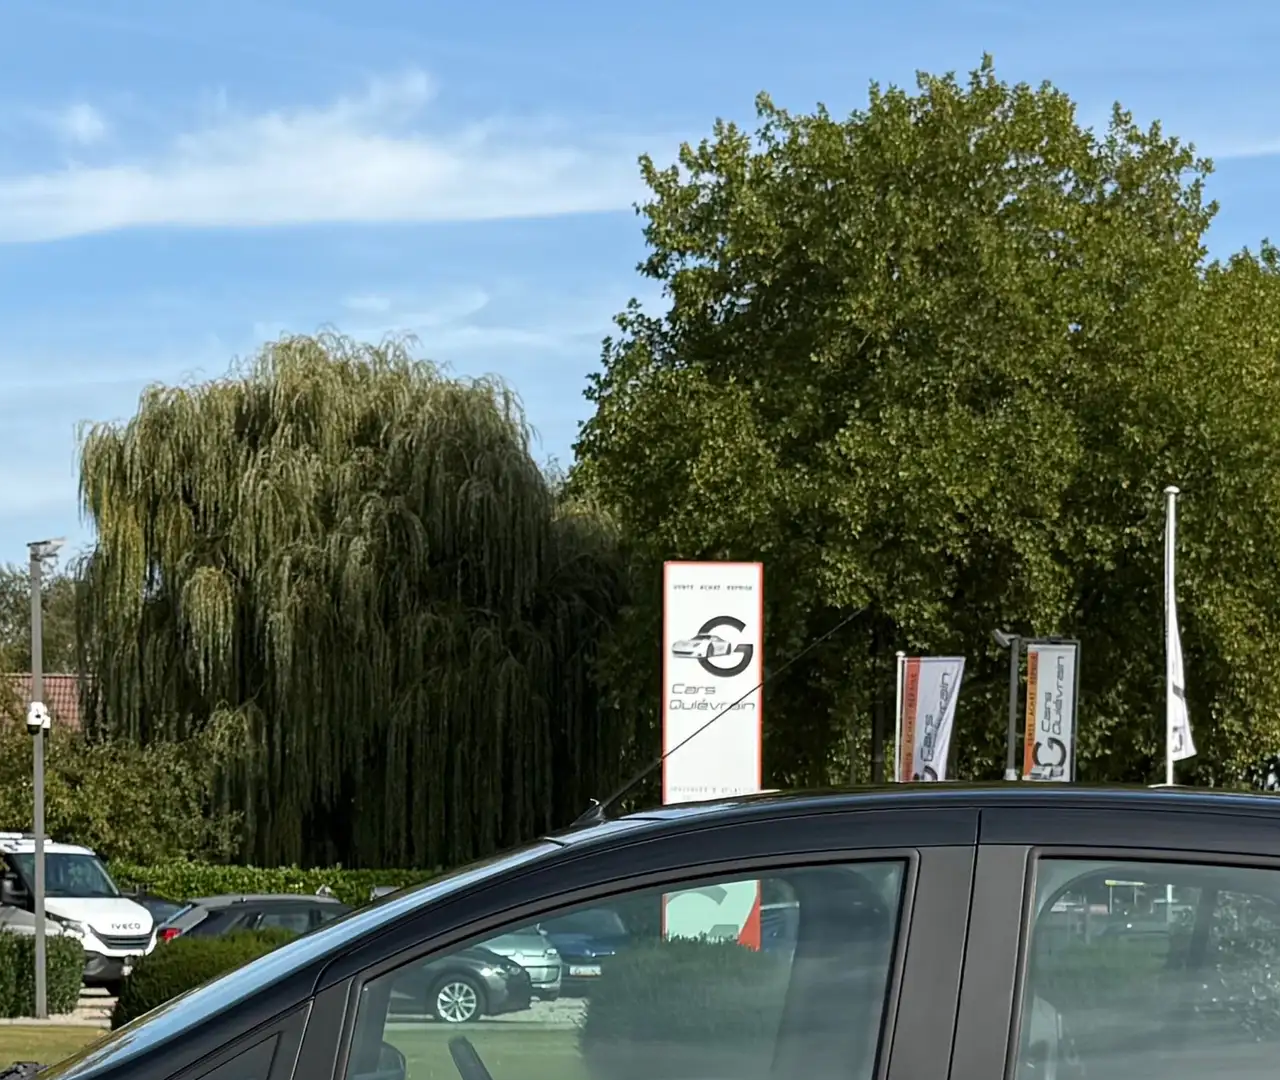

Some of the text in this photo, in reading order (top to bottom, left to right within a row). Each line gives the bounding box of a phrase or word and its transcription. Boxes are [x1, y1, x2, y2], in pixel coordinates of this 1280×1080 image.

[671, 683, 716, 695] Cars
[669, 698, 756, 711] Quiévrain
[1041, 691, 1052, 732] Cars
[111, 922, 141, 930] IVECO
